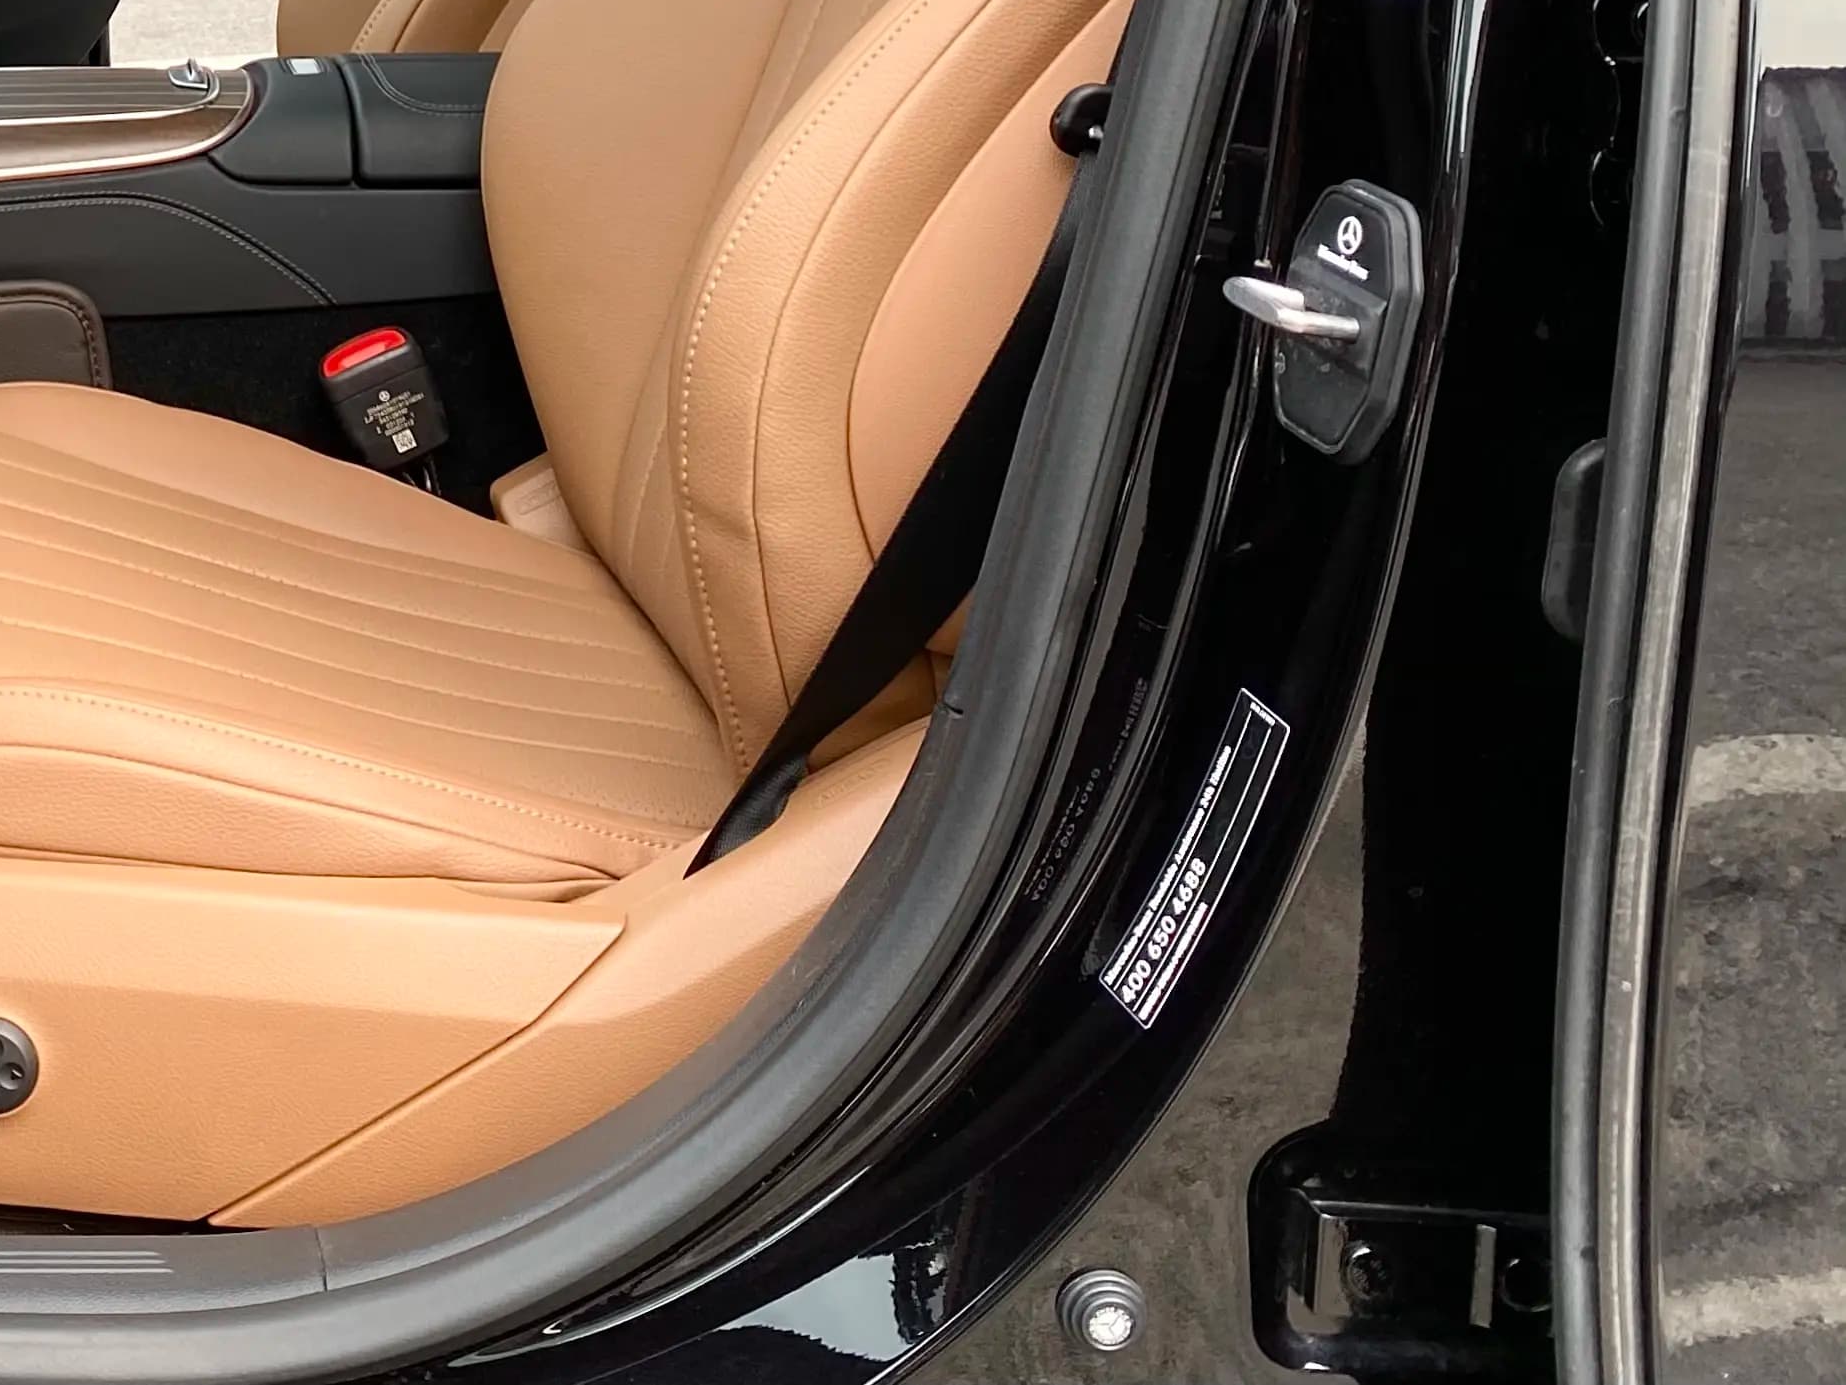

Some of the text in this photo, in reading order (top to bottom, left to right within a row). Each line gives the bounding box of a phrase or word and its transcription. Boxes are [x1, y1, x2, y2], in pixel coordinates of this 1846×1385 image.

[1121, 960, 1151, 1003] 400
[1148, 916, 1176, 960] 650
[1172, 858, 1205, 913] 4688
